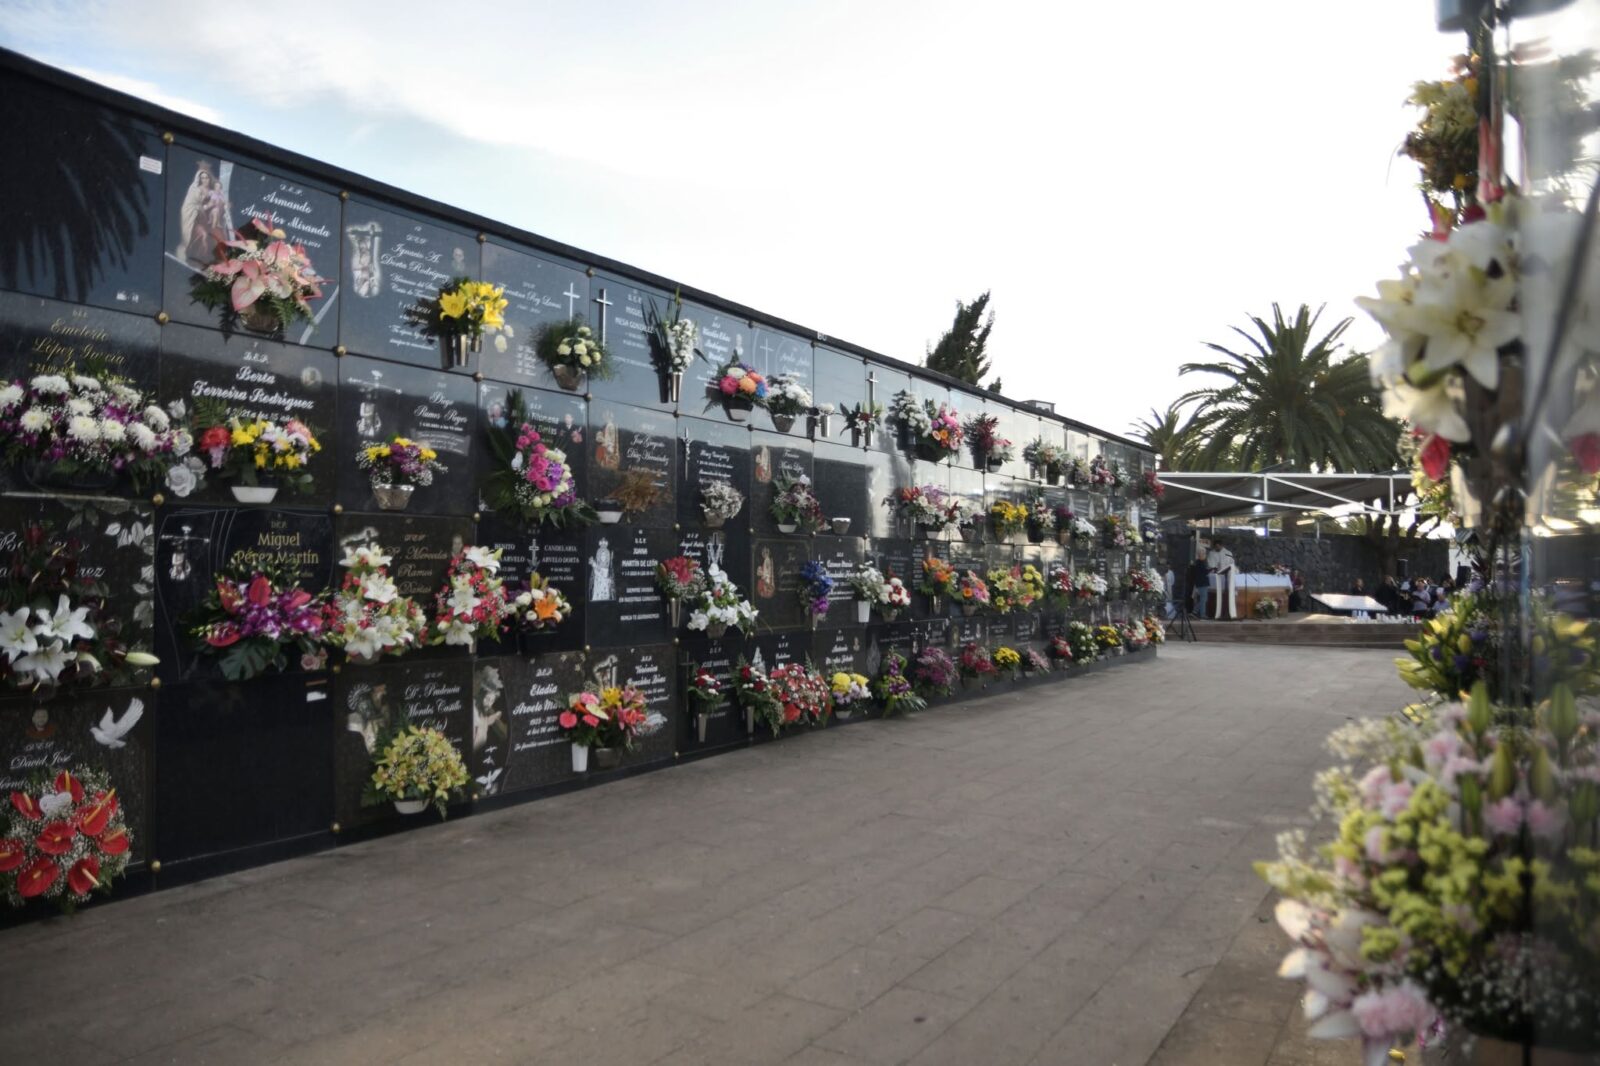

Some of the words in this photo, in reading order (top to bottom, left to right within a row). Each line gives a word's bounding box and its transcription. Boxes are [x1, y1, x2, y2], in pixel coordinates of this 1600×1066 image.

[263, 191, 313, 214] Armando
[287, 217, 331, 237] Miranda
[249, 388, 315, 411] Rodríguez
[257, 531, 301, 550] Miguel
[494, 543, 516, 551] BENITO
[544, 544, 577, 552] CANDELARIA
[234, 549, 273, 564] Pérez
[276, 548, 320, 564] Martín
[529, 683, 558, 697] Eladia
[512, 701, 543, 715] Arvelo
